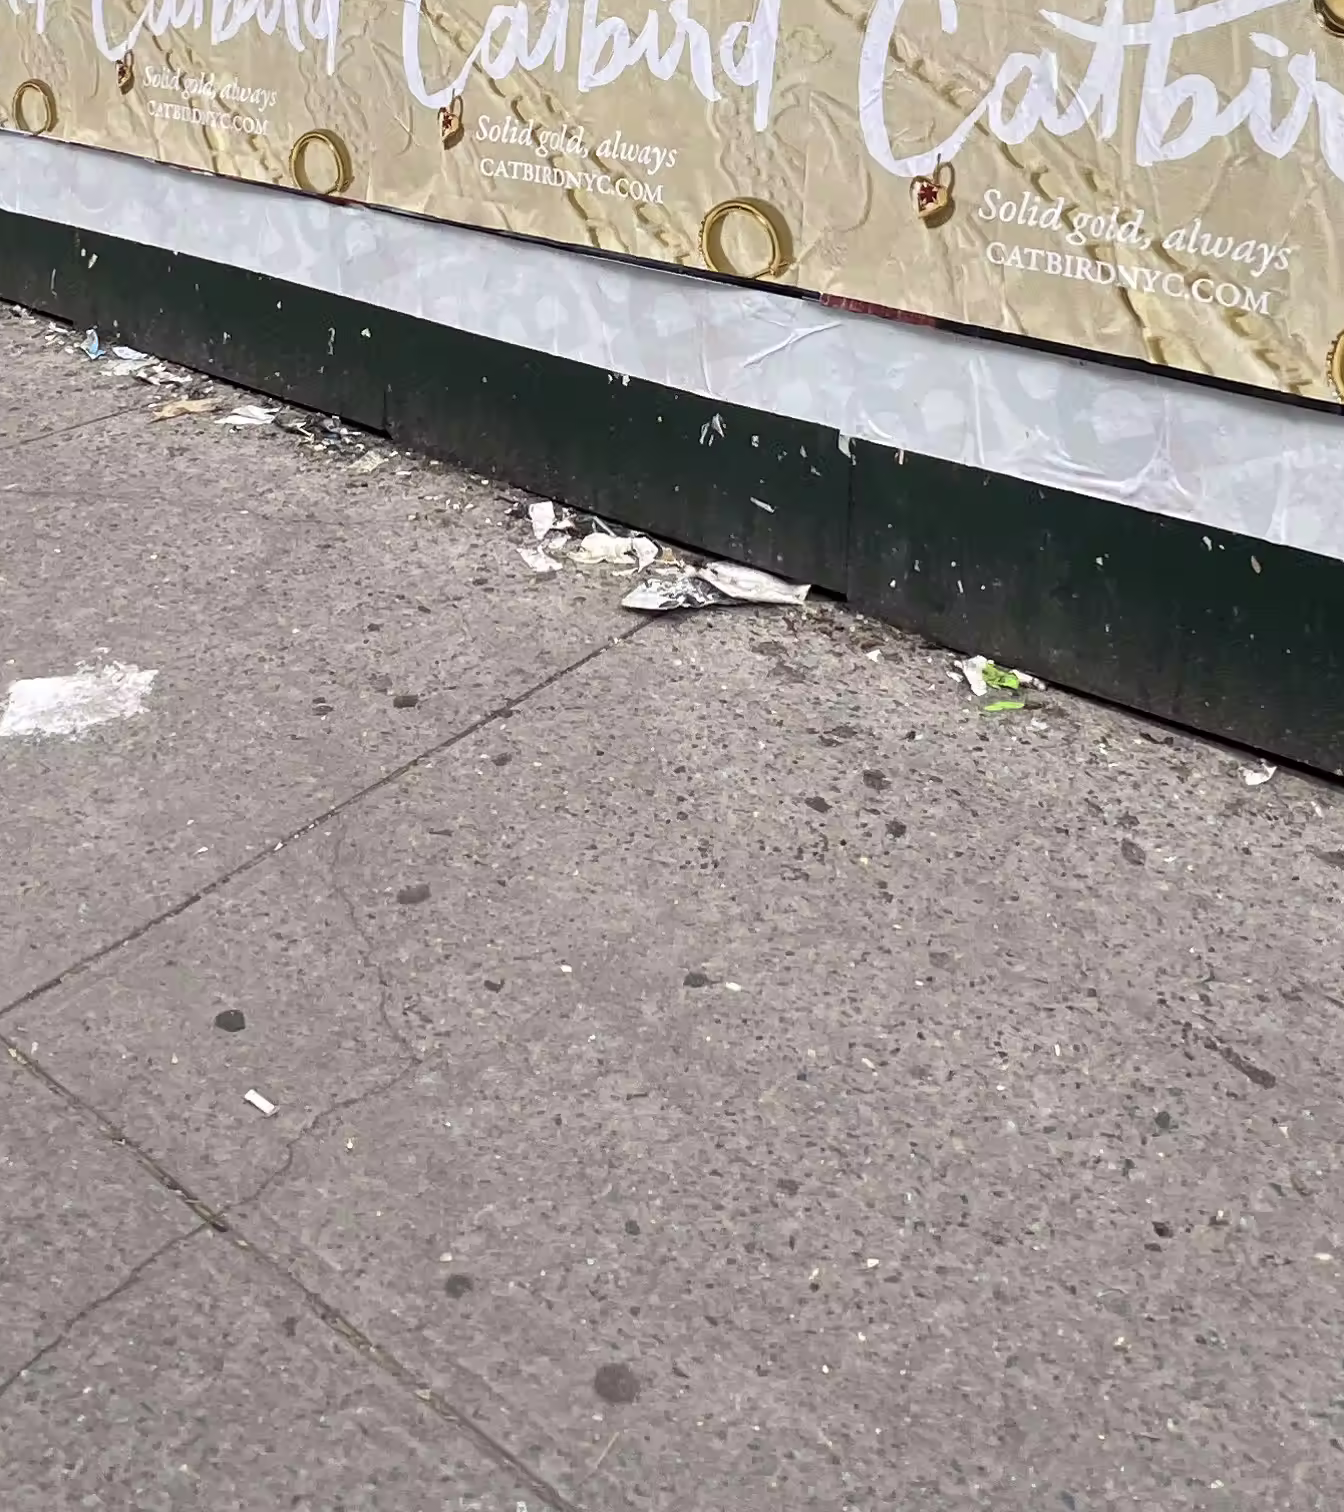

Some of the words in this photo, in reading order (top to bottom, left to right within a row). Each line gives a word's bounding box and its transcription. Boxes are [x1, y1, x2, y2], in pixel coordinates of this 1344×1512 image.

[143, 65, 181, 90] Solid
[219, 76, 279, 113] always
[475, 115, 534, 149] Solid
[537, 123, 591, 161] gold,
[595, 131, 679, 174] always
[479, 156, 665, 205] CATBIRDNYC.COM
[977, 188, 1064, 231] Solid
[1065, 200, 1152, 252] gold,
[1154, 219, 1293, 274] always
[985, 240, 1273, 316] CATBIRDNYC.COM
